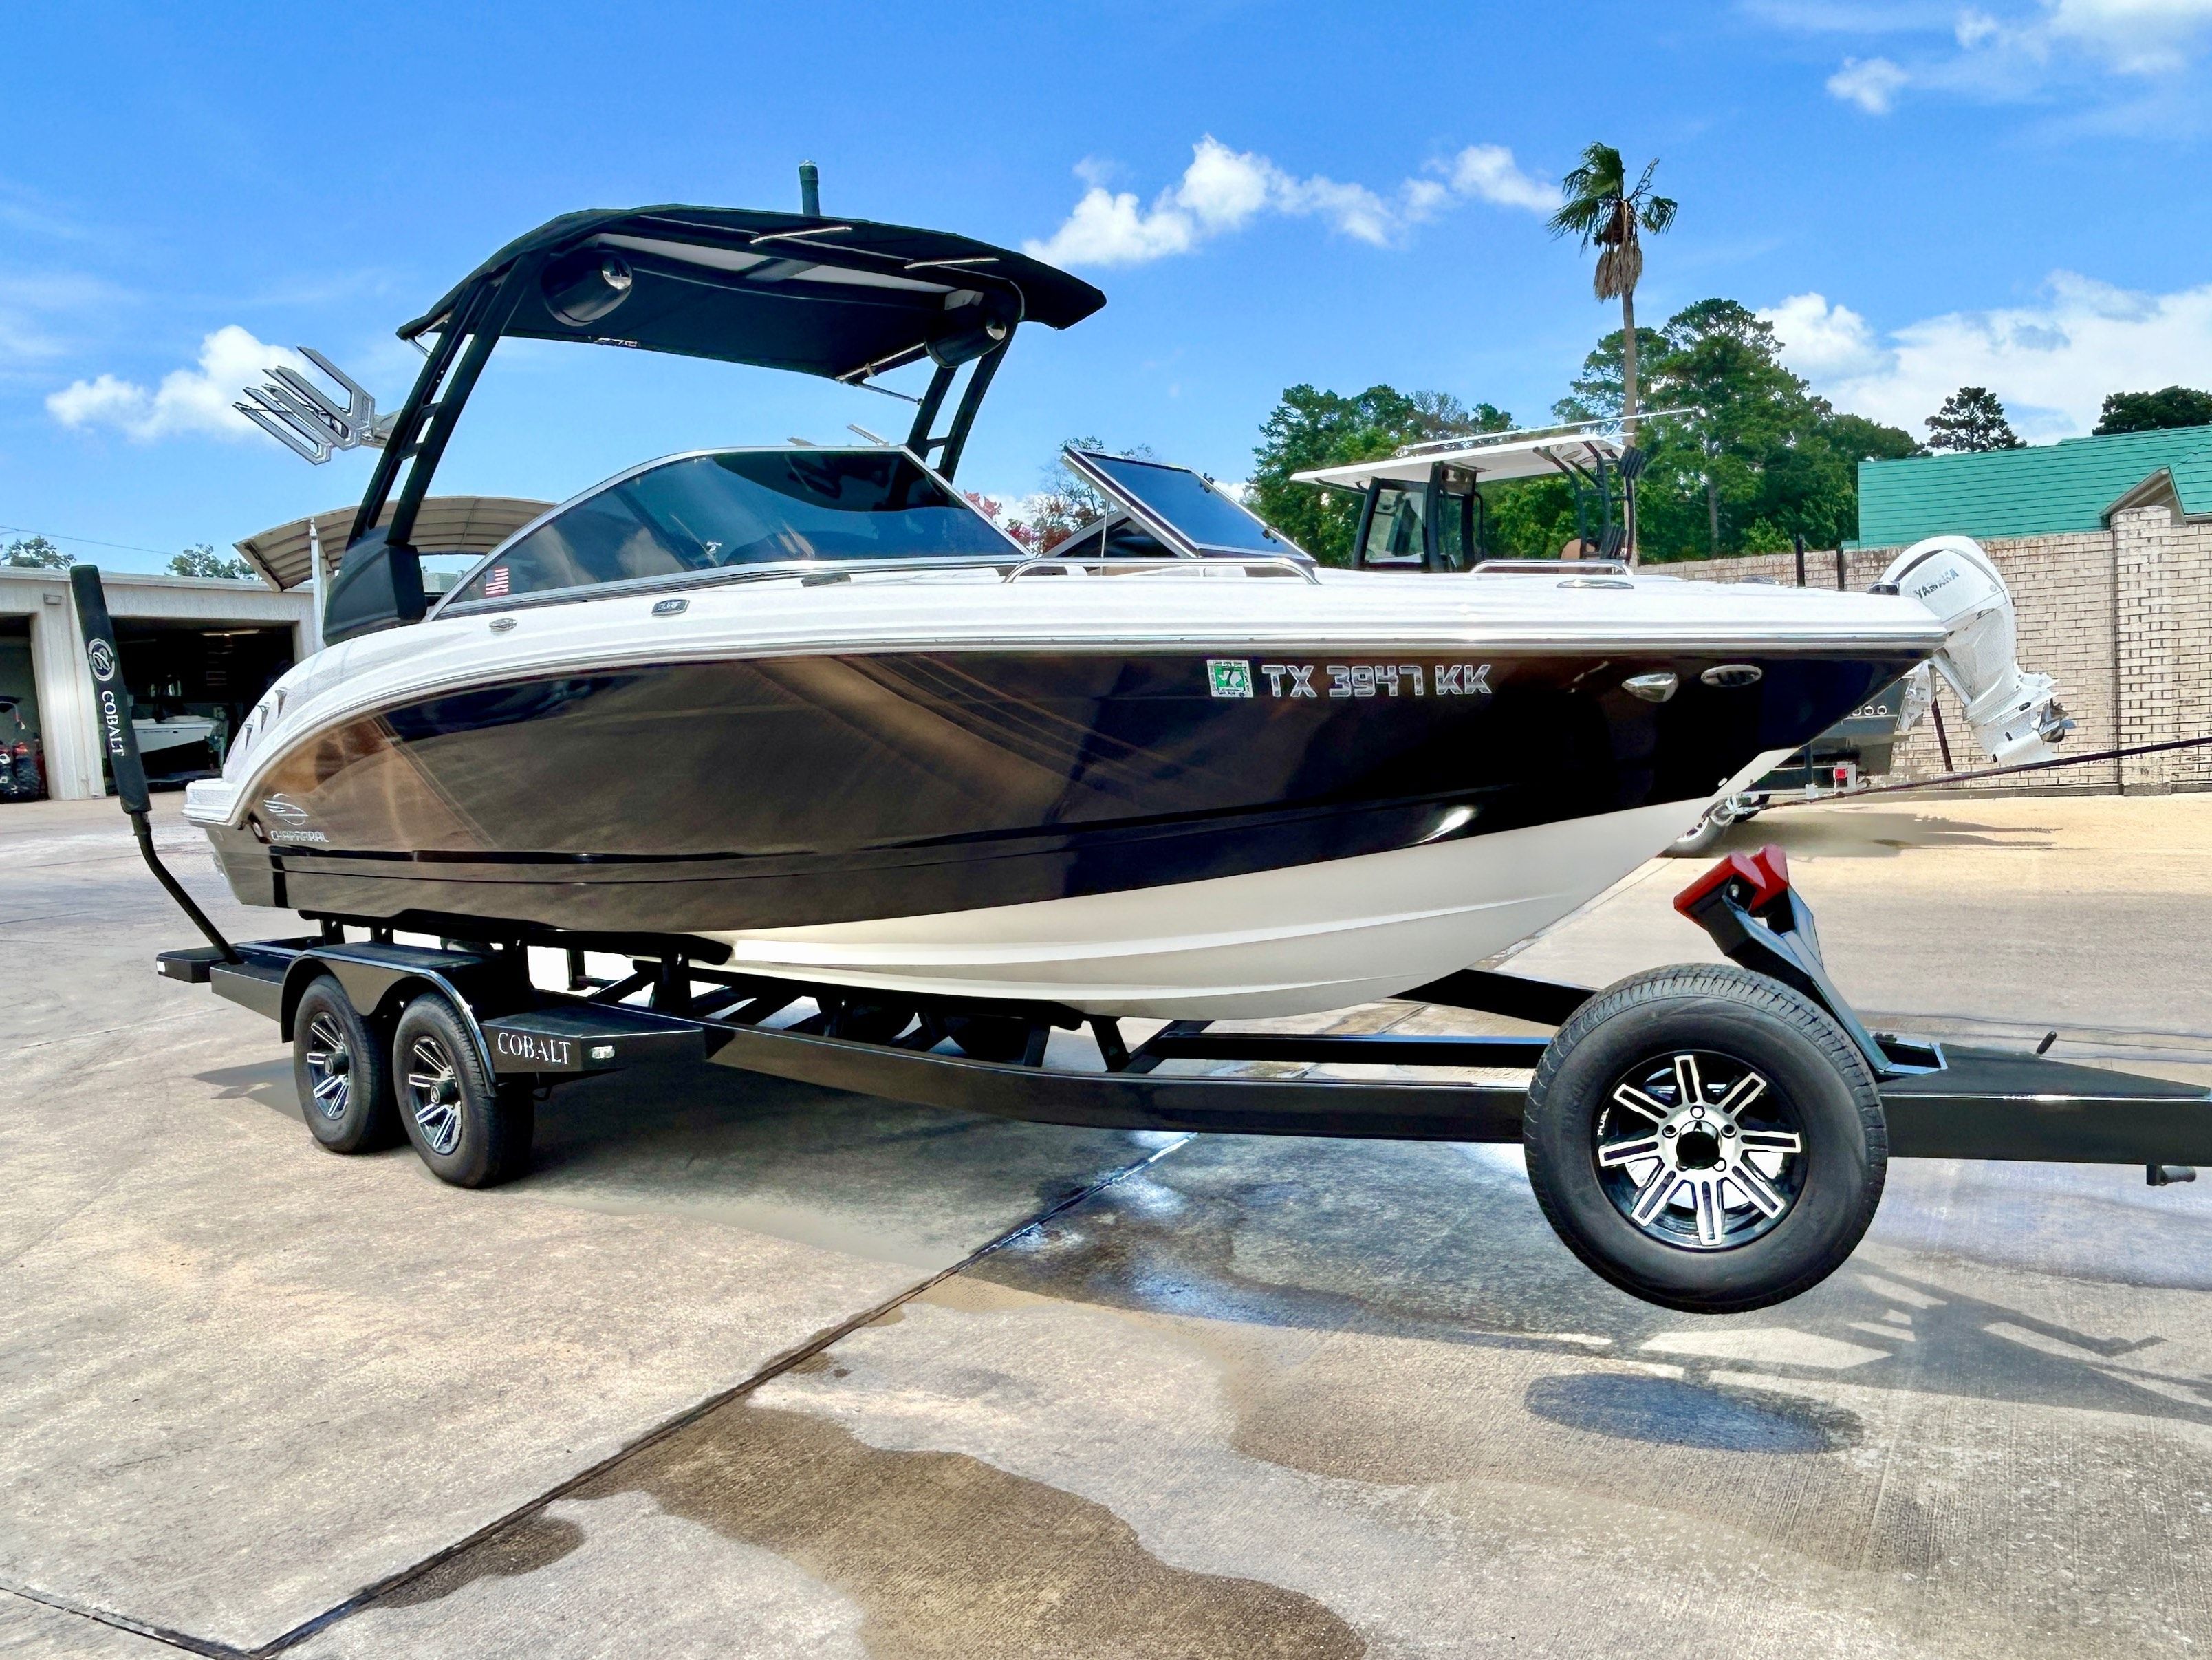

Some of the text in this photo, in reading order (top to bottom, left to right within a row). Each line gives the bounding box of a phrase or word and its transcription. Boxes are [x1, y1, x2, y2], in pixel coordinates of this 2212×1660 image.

[1261, 664, 1492, 698] TX 3947 KK
[102, 690, 125, 757] COBALT
[497, 1032, 572, 1065] COBALT
